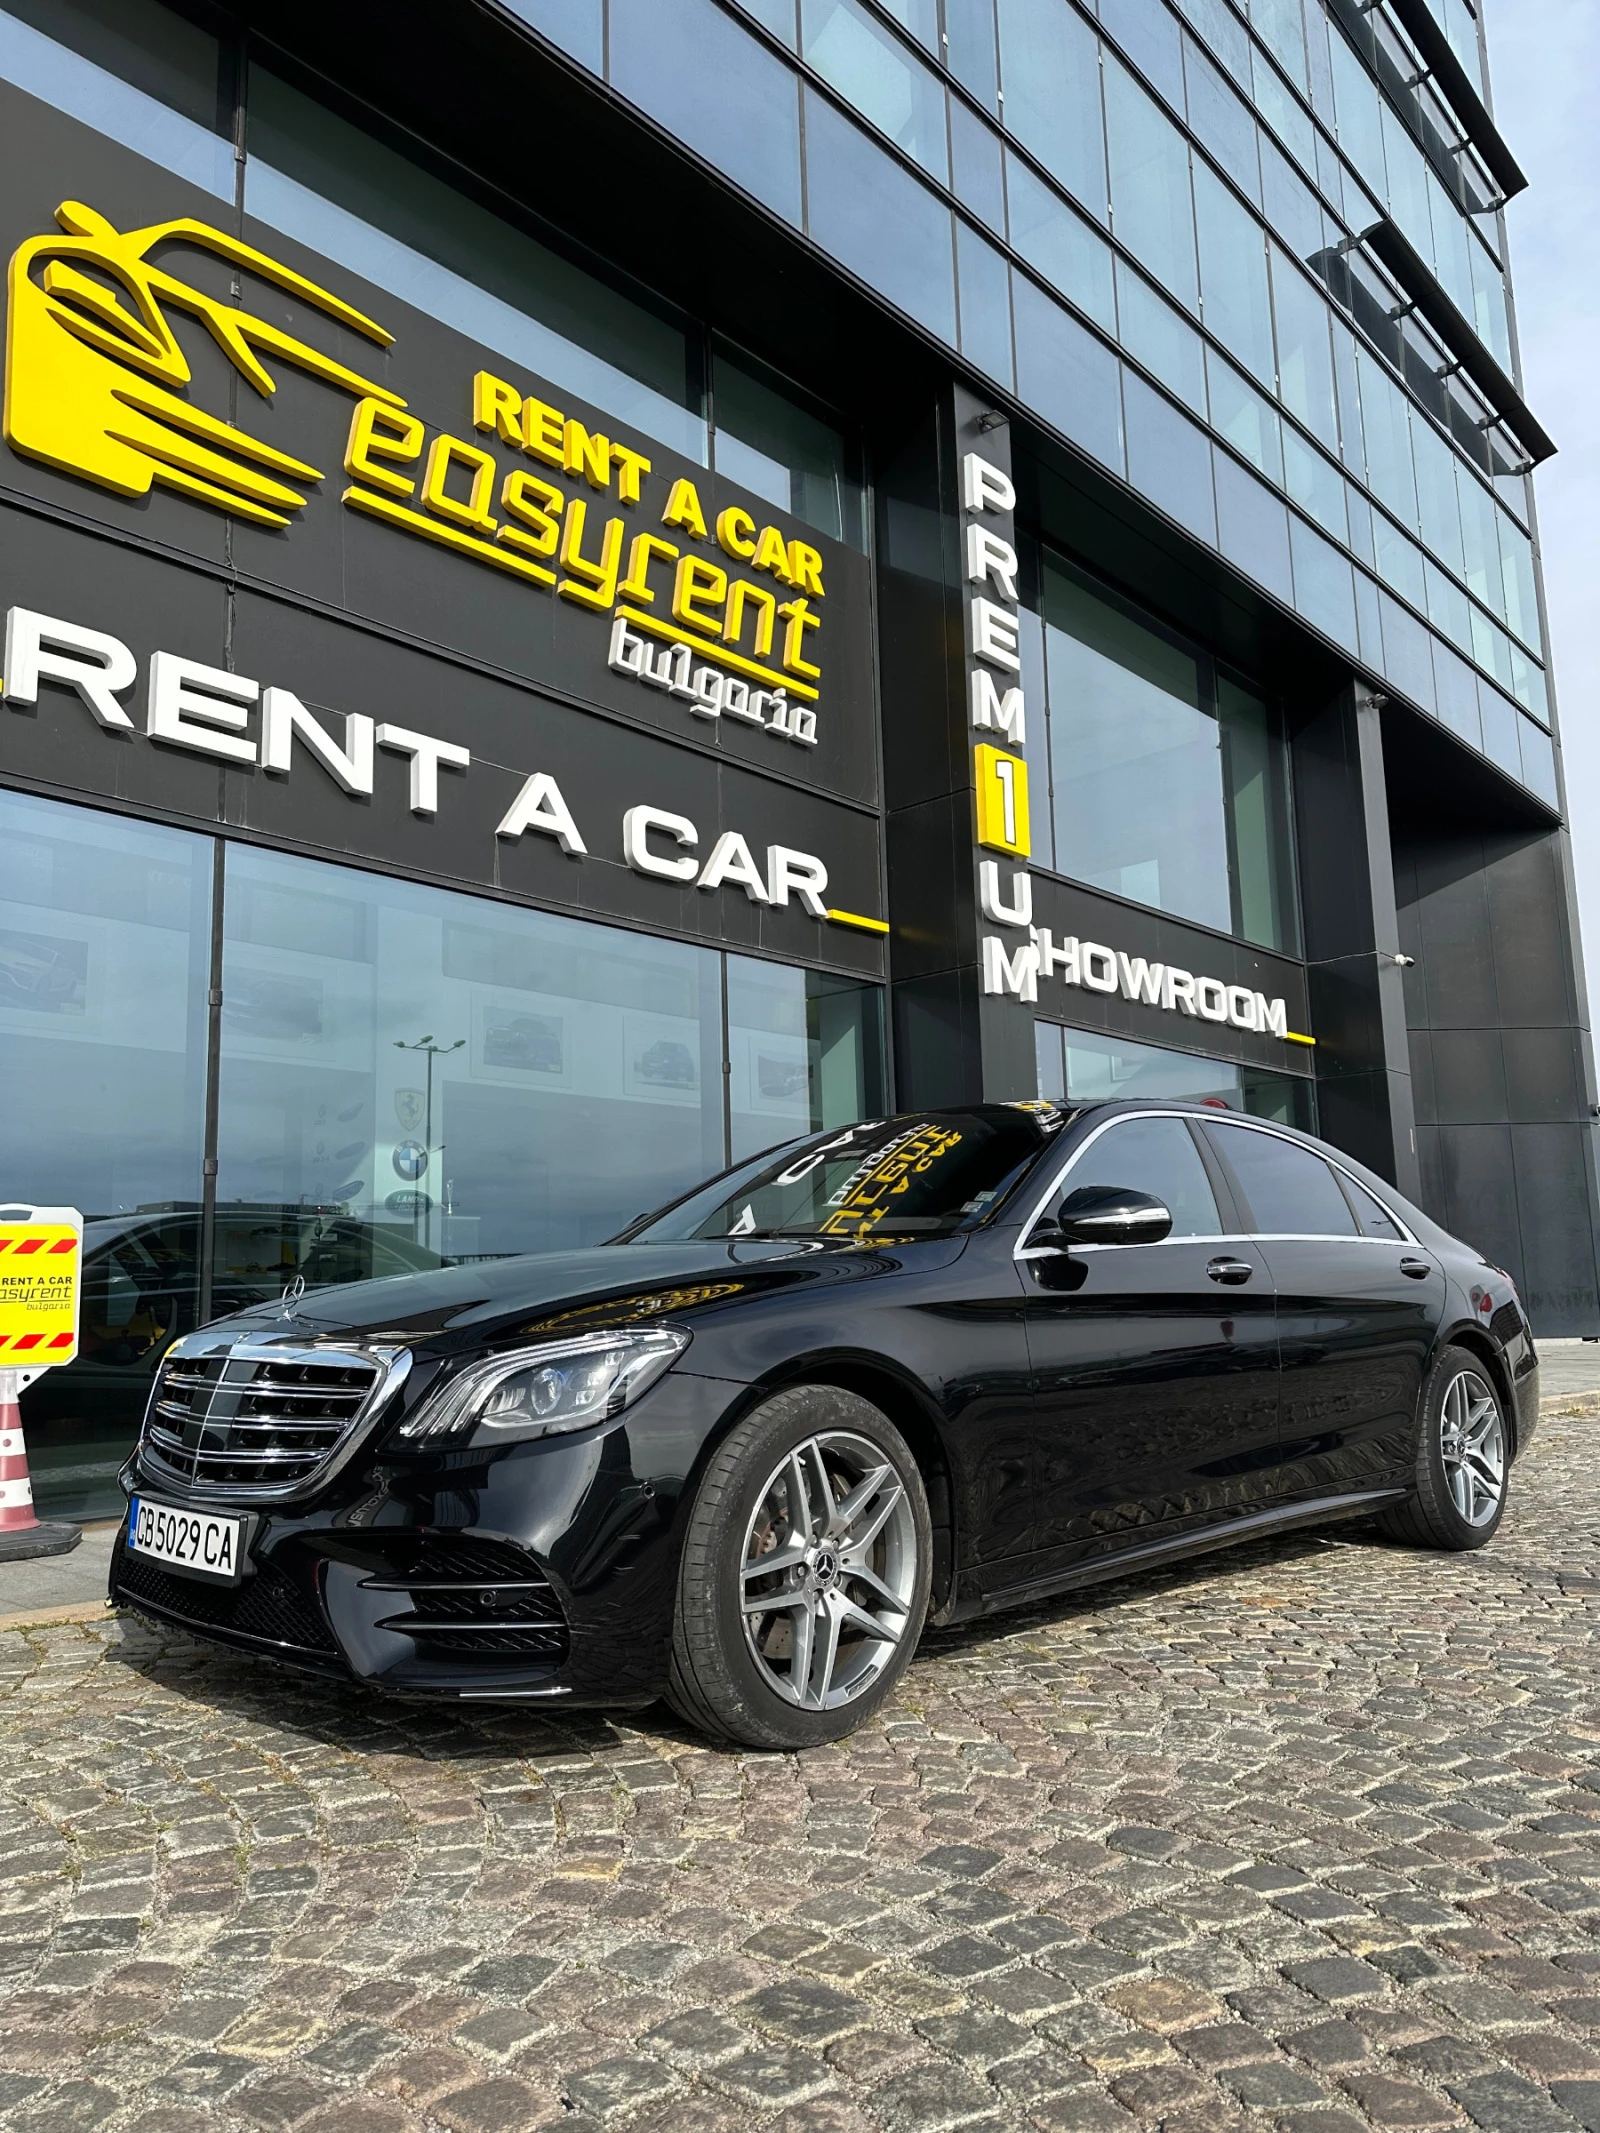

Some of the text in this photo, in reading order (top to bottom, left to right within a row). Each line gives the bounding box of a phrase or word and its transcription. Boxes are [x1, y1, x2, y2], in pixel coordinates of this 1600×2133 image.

[343, 396, 821, 680] easyrent
[473, 370, 825, 599] RENT A CAR
[2, 605, 829, 918] RENT A CAR
[608, 617, 818, 745] bulgaria
[2, 1276, 72, 1286] RENT A CAR
[26, 1303, 70, 1312] bulgaria
